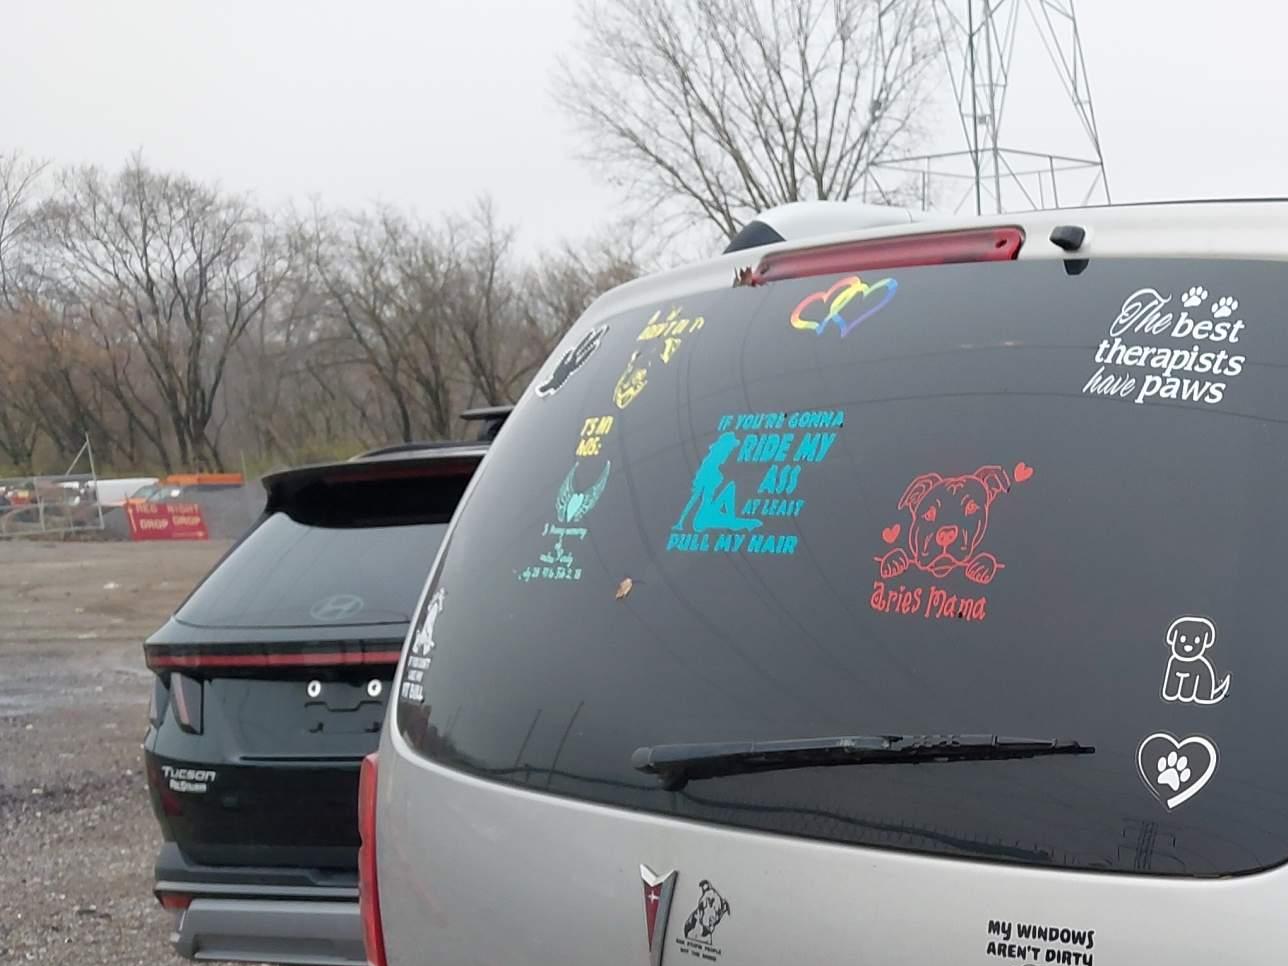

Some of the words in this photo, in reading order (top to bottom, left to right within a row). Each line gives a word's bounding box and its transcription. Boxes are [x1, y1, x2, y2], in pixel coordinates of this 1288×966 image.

[1109, 288, 1172, 337] The
[1171, 312, 1245, 343] best
[1094, 338, 1245, 377] therapists
[1082, 365, 1136, 397] have
[1135, 374, 1226, 404] paws
[717, 415, 733, 431] IF
[735, 411, 786, 430] YOU'RE
[788, 410, 845, 428] GONNA
[737, 433, 794, 463] RIDE
[793, 432, 837, 463] MY
[757, 464, 801, 495] ASS
[741, 499, 761, 515] AT
[761, 499, 805, 517] LEAST
[139, 518, 168, 529] DROP
[172, 515, 201, 525] DROP
[666, 533, 710, 551] PULL
[714, 534, 745, 553] MY
[747, 534, 798, 554] HAIR
[1017, 923, 1095, 949] WINDOWS
[986, 941, 1041, 961] AREN'T
